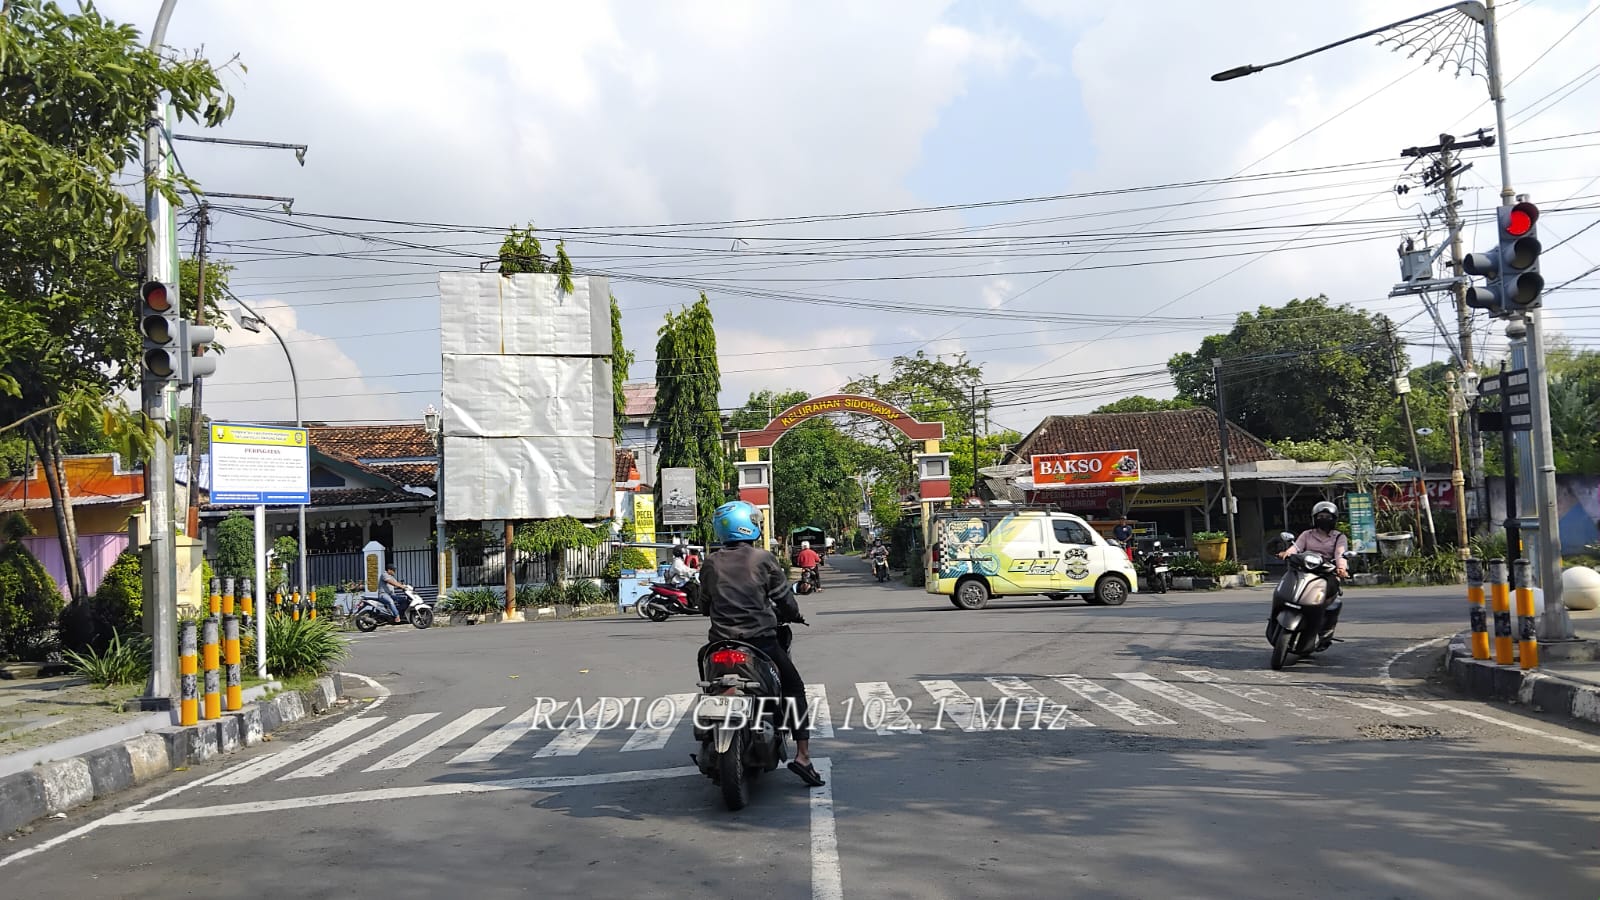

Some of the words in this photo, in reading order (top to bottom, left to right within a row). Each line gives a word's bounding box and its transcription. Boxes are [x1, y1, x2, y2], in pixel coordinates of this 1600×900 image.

[781, 400, 840, 427] KELURAHAN
[844, 398, 900, 421] SIDOWAYAH
[1040, 459, 1103, 475] BAKSO
[636, 510, 653, 519] PECEL
